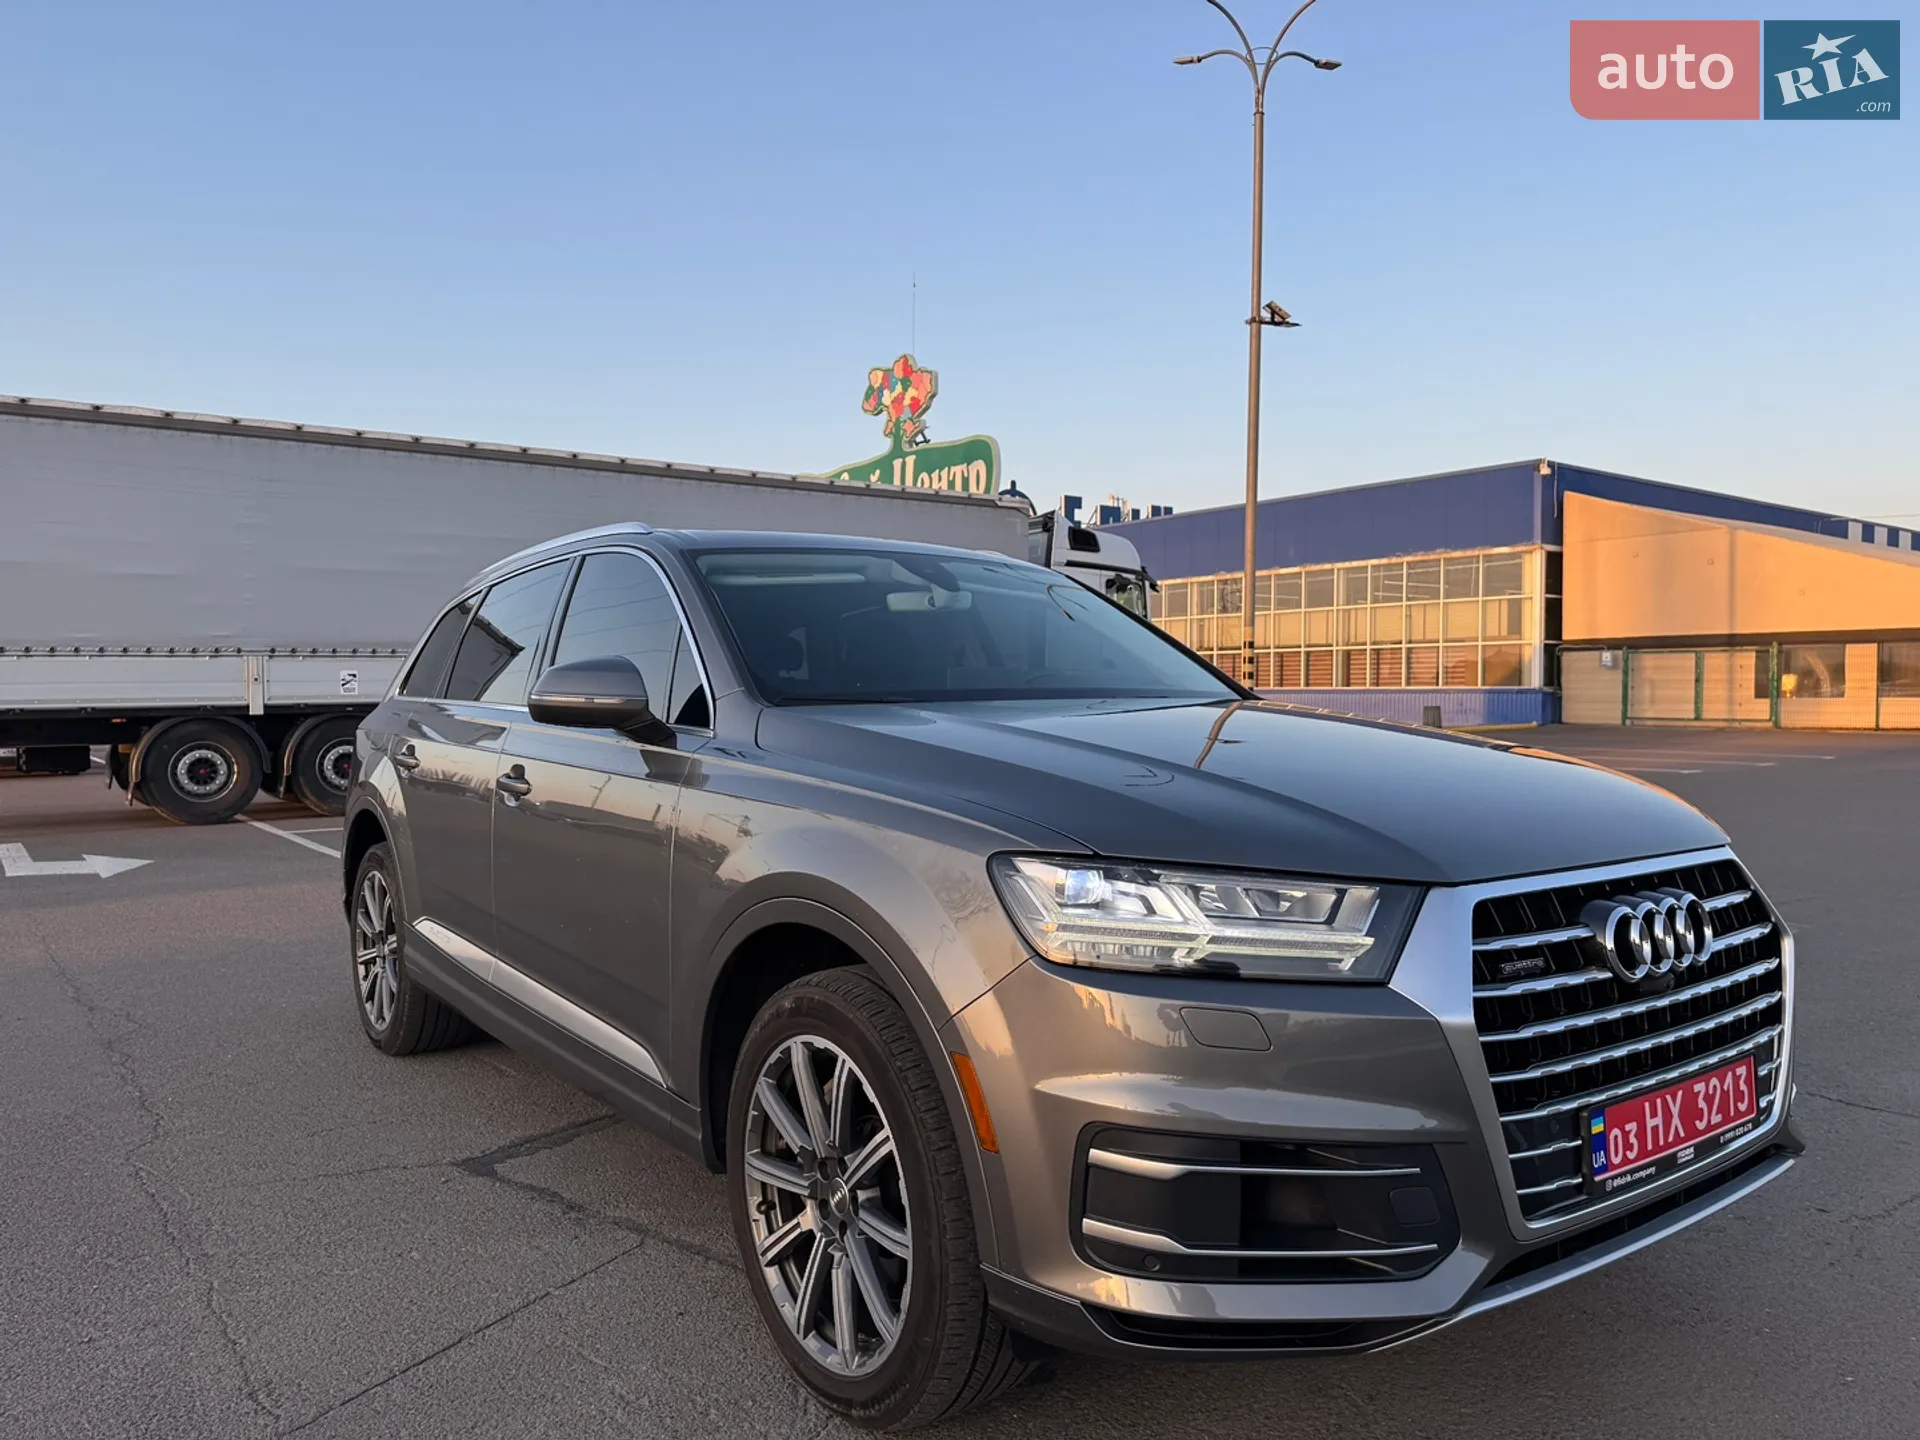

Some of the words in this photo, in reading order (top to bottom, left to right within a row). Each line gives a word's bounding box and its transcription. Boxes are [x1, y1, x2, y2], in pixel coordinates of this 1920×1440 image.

[1609, 1121, 1639, 1165] 03
[1644, 1089, 1685, 1151] HX
[1693, 1065, 1749, 1130] 3213
[1592, 1150, 1607, 1168] UA
